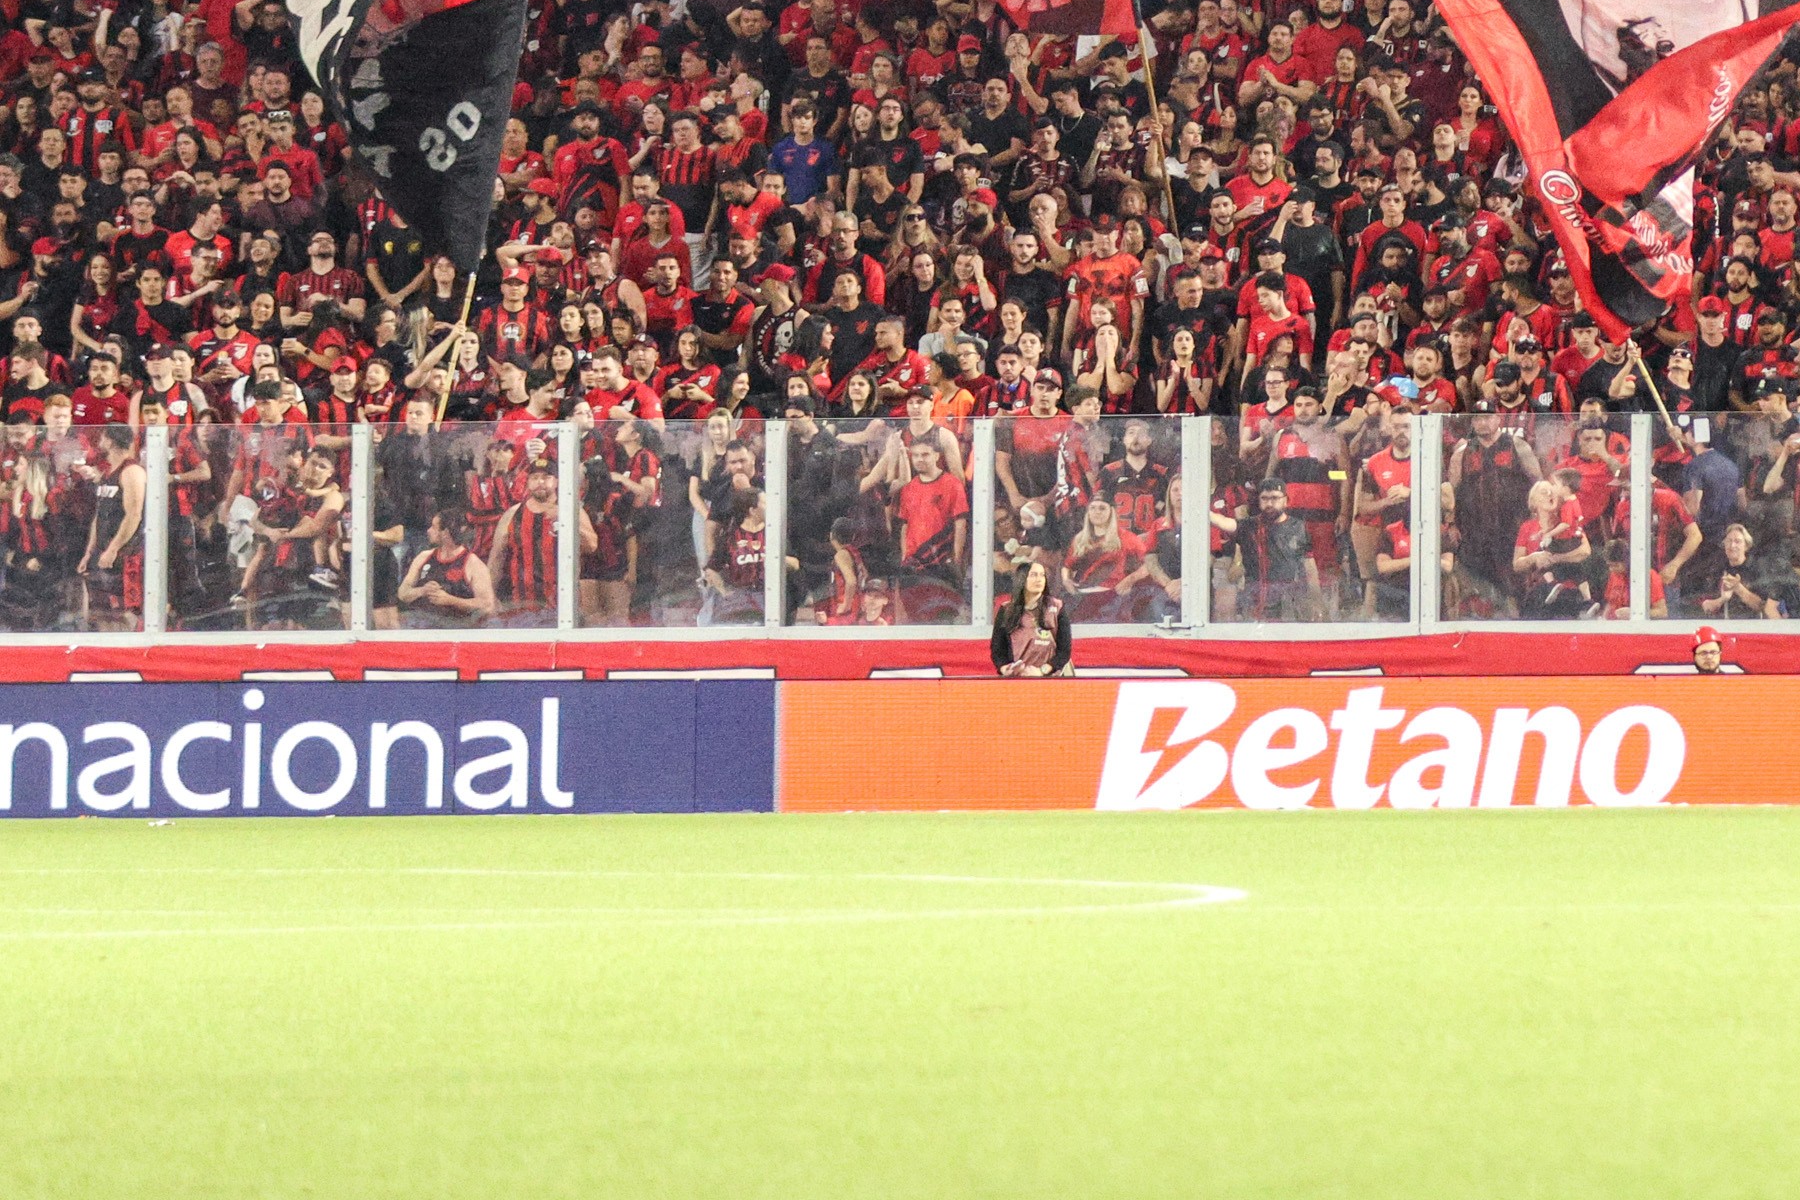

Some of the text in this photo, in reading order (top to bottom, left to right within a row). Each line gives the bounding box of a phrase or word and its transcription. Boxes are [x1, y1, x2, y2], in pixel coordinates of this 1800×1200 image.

[1113, 492, 1156, 535] 20
[0, 688, 574, 810] nacional
[1095, 681, 1686, 809] Betano
